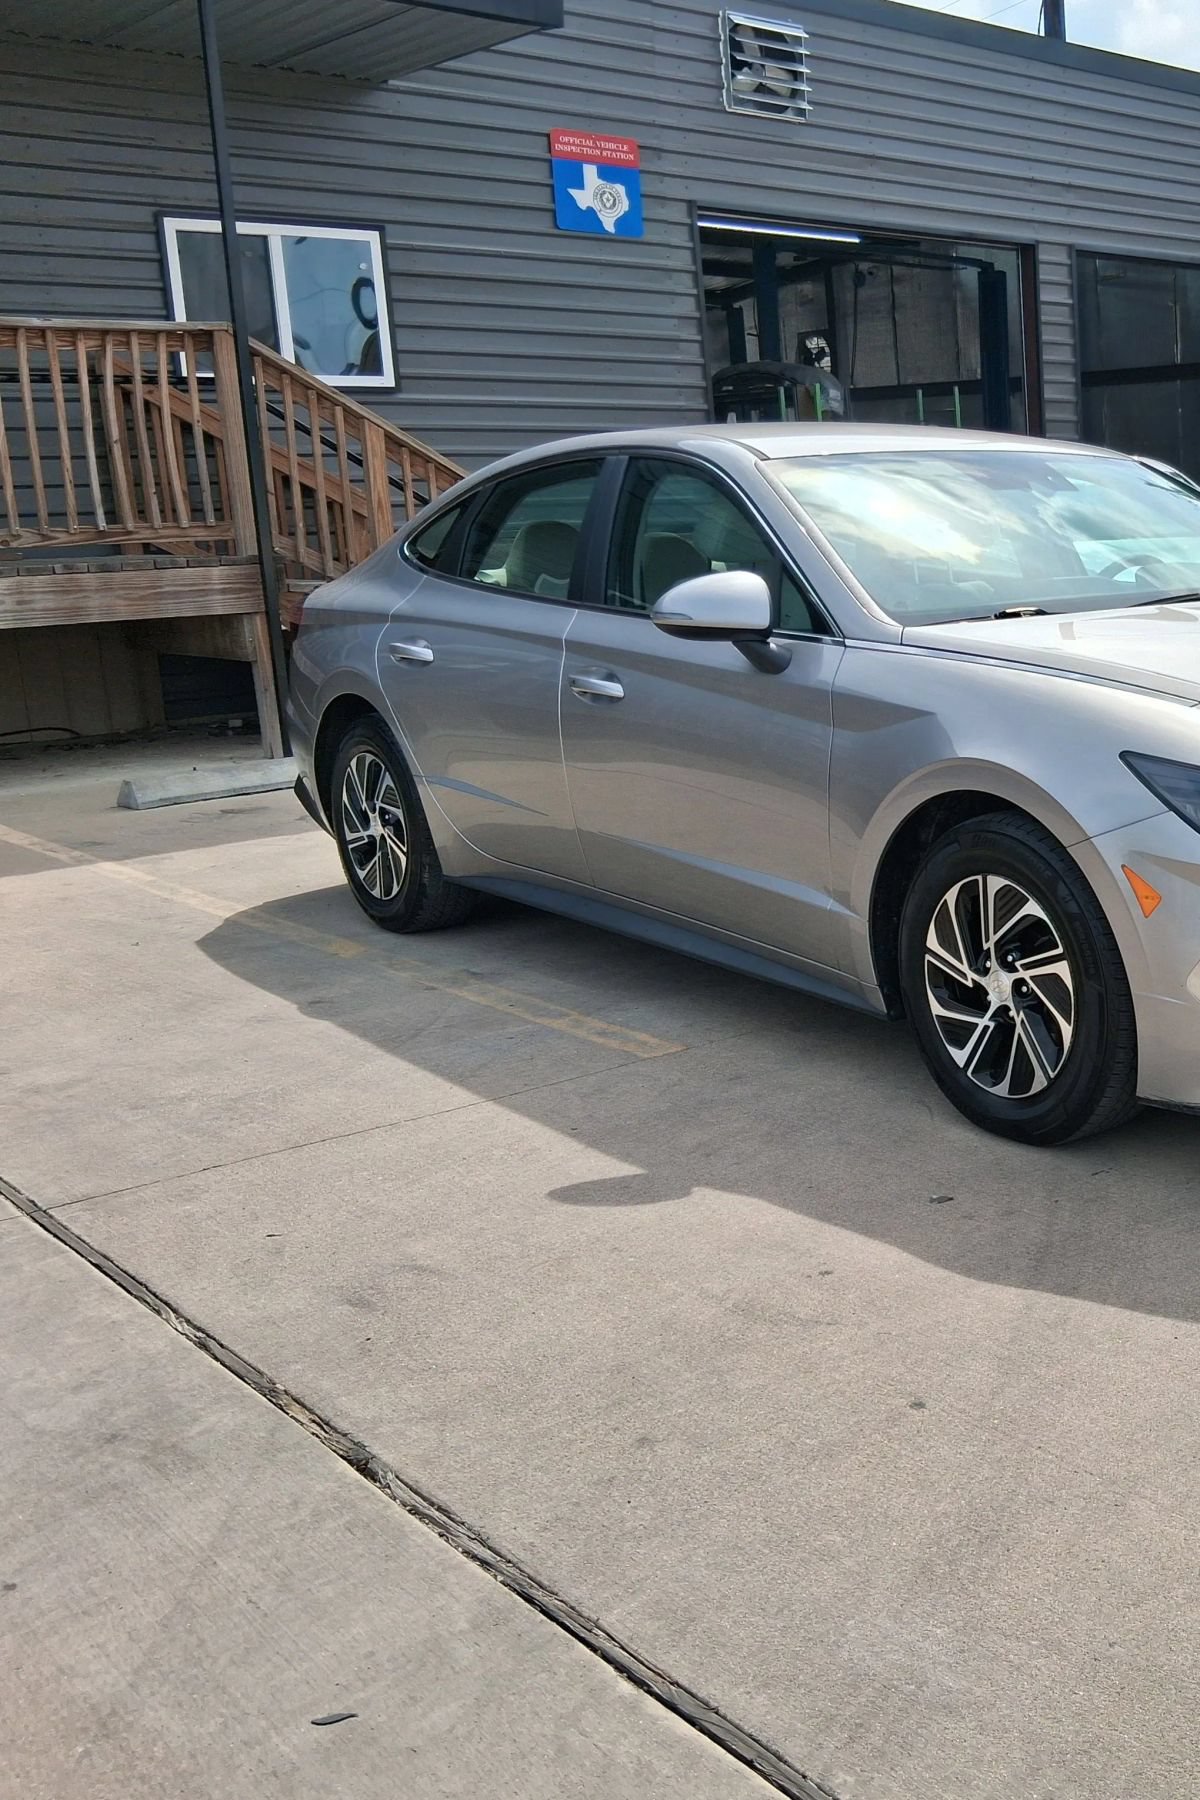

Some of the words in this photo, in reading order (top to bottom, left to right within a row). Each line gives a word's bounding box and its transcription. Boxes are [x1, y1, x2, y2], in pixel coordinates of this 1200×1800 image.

[560, 136, 595, 147] OFFICIAL
[596, 140, 629, 152] VEHICLE
[555, 144, 600, 156] INSPECTION
[602, 150, 634, 161] STATION
